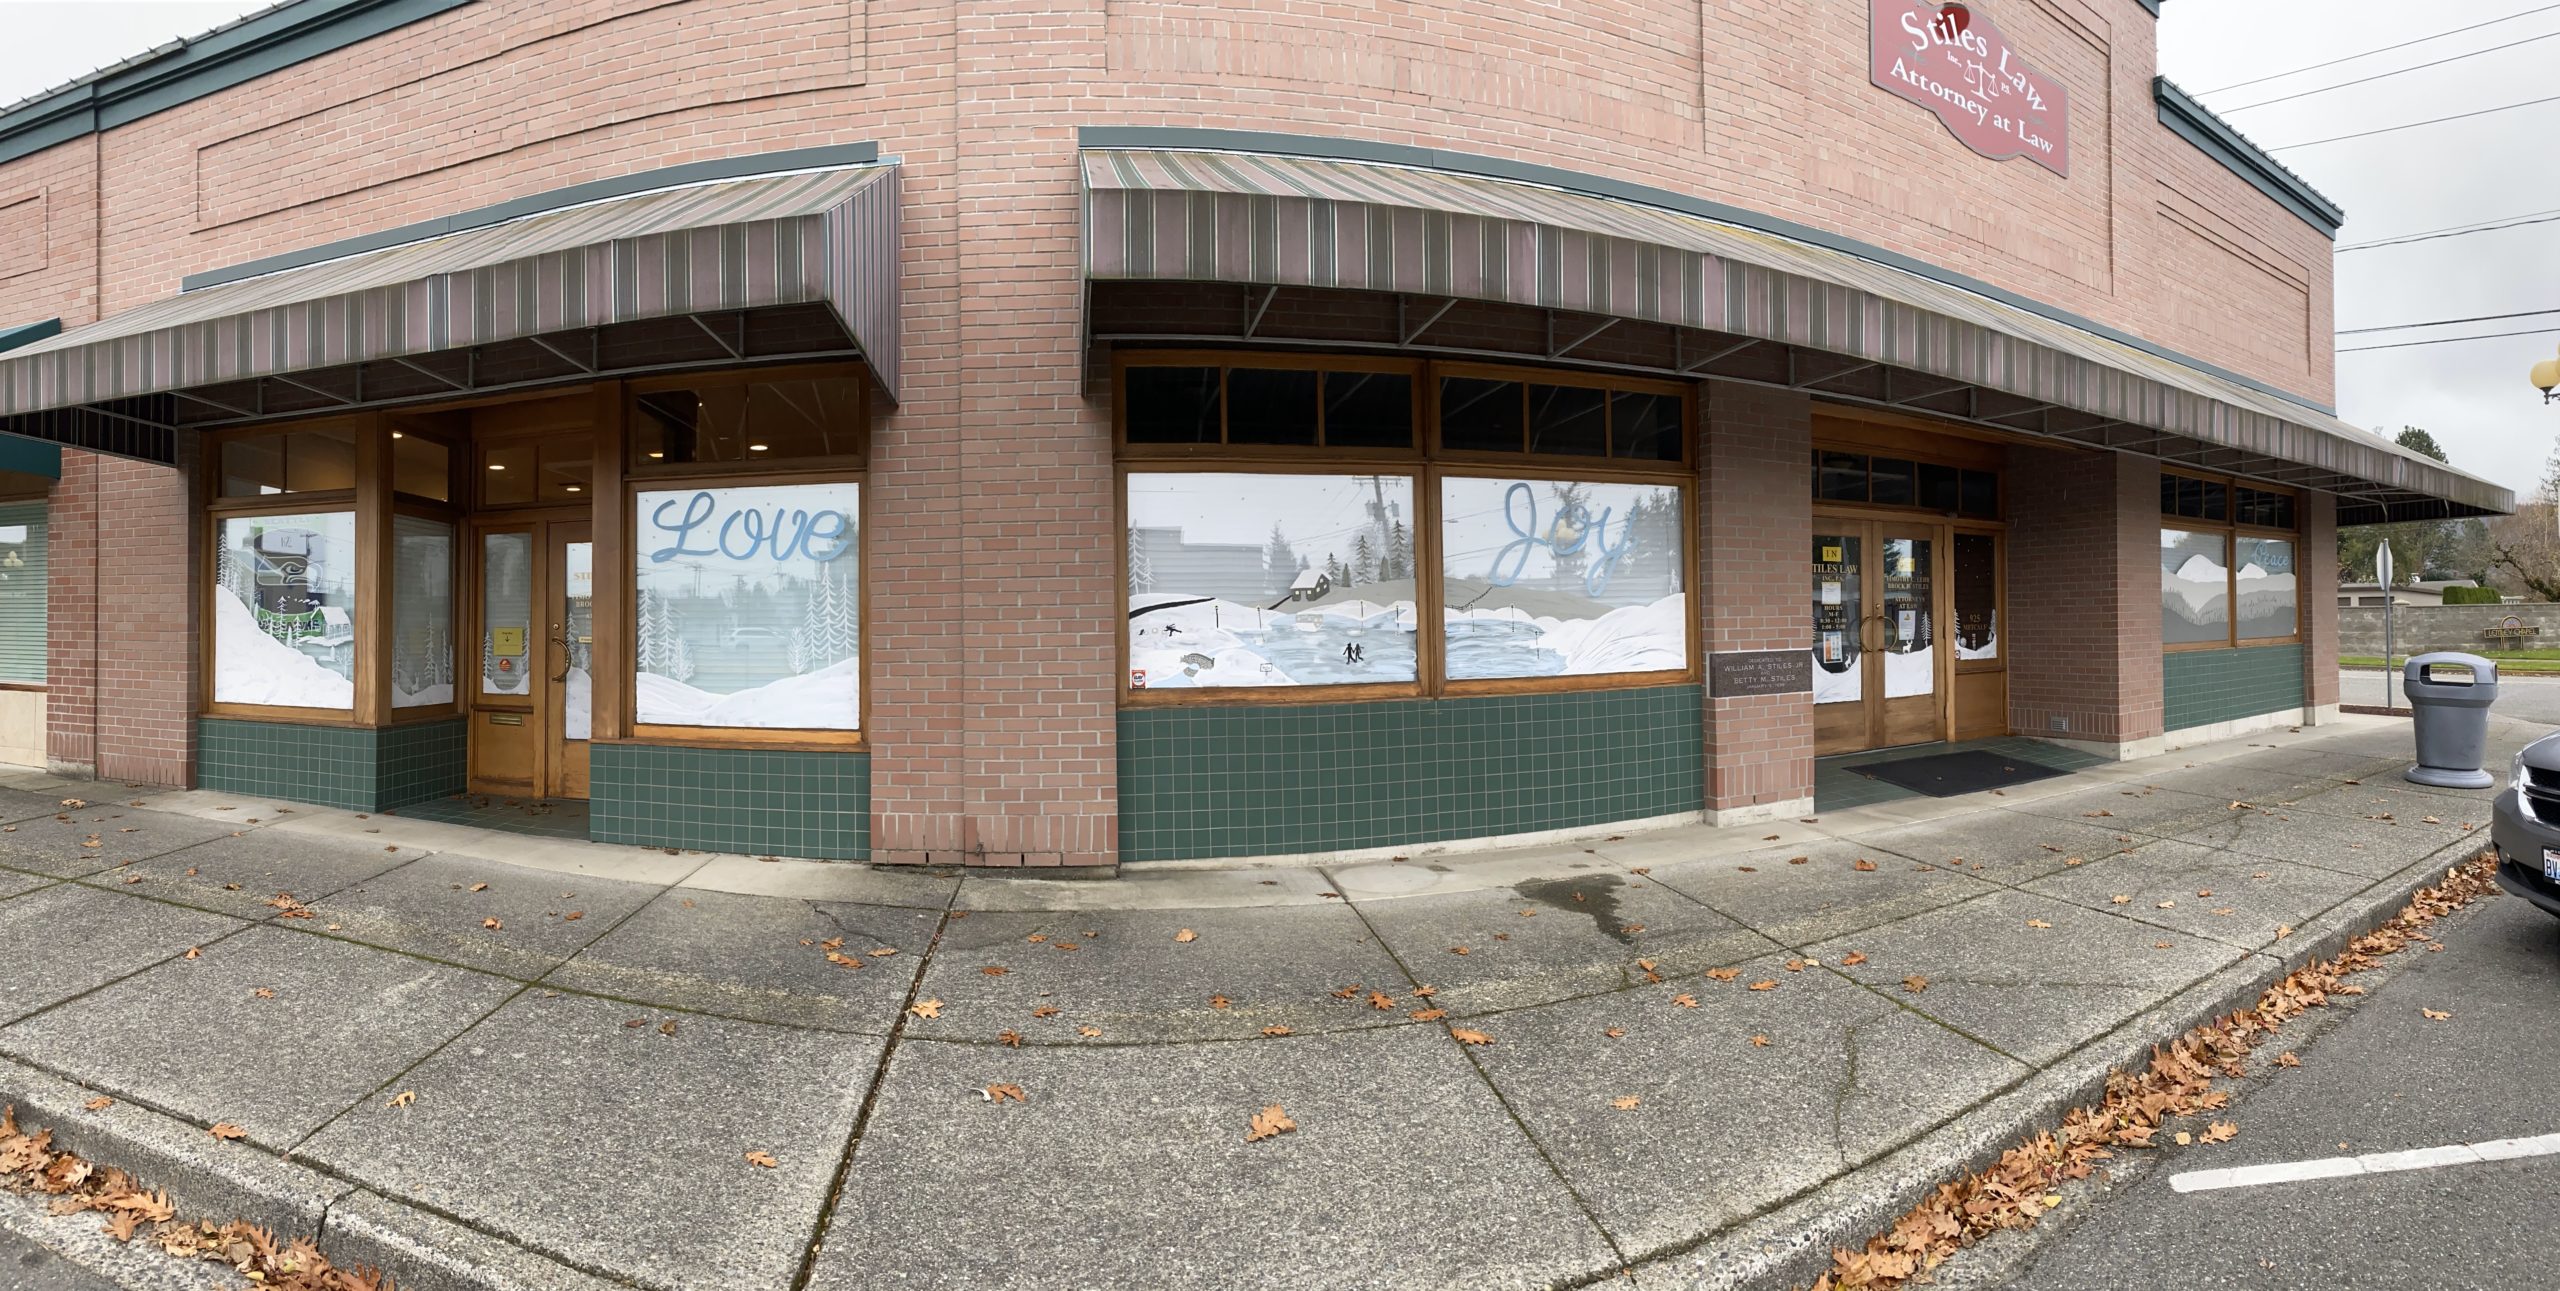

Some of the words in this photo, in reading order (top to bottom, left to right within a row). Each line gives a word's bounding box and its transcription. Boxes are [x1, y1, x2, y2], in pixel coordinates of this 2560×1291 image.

[1901, 11, 1988, 57] Stiles
[1998, 46, 2048, 112] Law
[1890, 57, 1988, 125] Attorney
[1993, 114, 2011, 132] at
[2018, 119, 2053, 153] Law
[651, 491, 849, 563] Love
[1488, 482, 1640, 598] Joy
[2252, 541, 2289, 567] Peace
[1840, 564, 1858, 574] LAW
[1969, 613, 1981, 623] 925
[2514, 627, 2536, 635] CHAPEL
[1724, 664, 1754, 672] WILLIAM
[1767, 662, 1792, 670] STILES
[1734, 676, 1757, 684] BETTY
[1771, 674, 1796, 682] STILES
